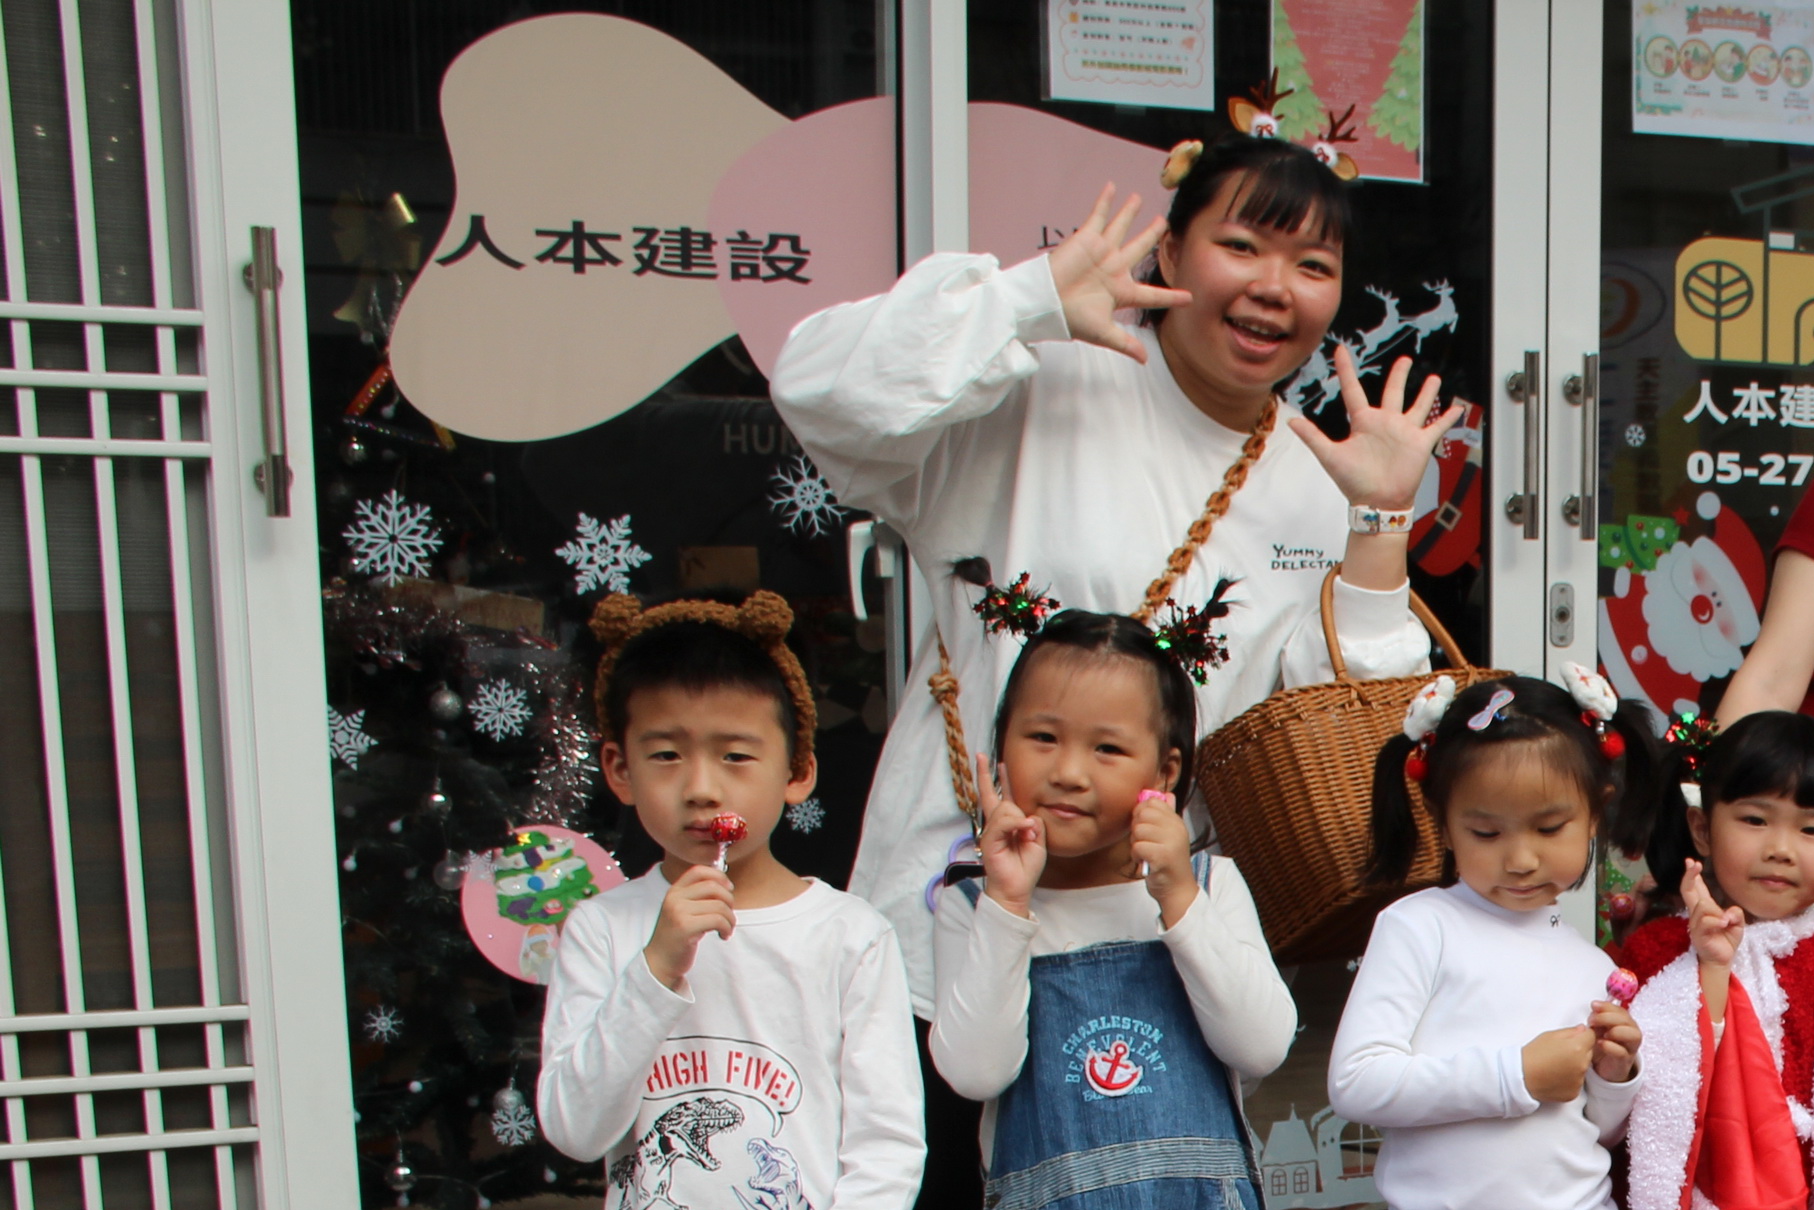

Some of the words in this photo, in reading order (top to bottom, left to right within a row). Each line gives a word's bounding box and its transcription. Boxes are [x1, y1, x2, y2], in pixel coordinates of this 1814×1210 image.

[436, 214, 812, 285] 人本建設
[1062, 1015, 1164, 1055] CHARLESTON
[646, 1050, 709, 1093] HIGH
[726, 1050, 797, 1107] FIVE!
